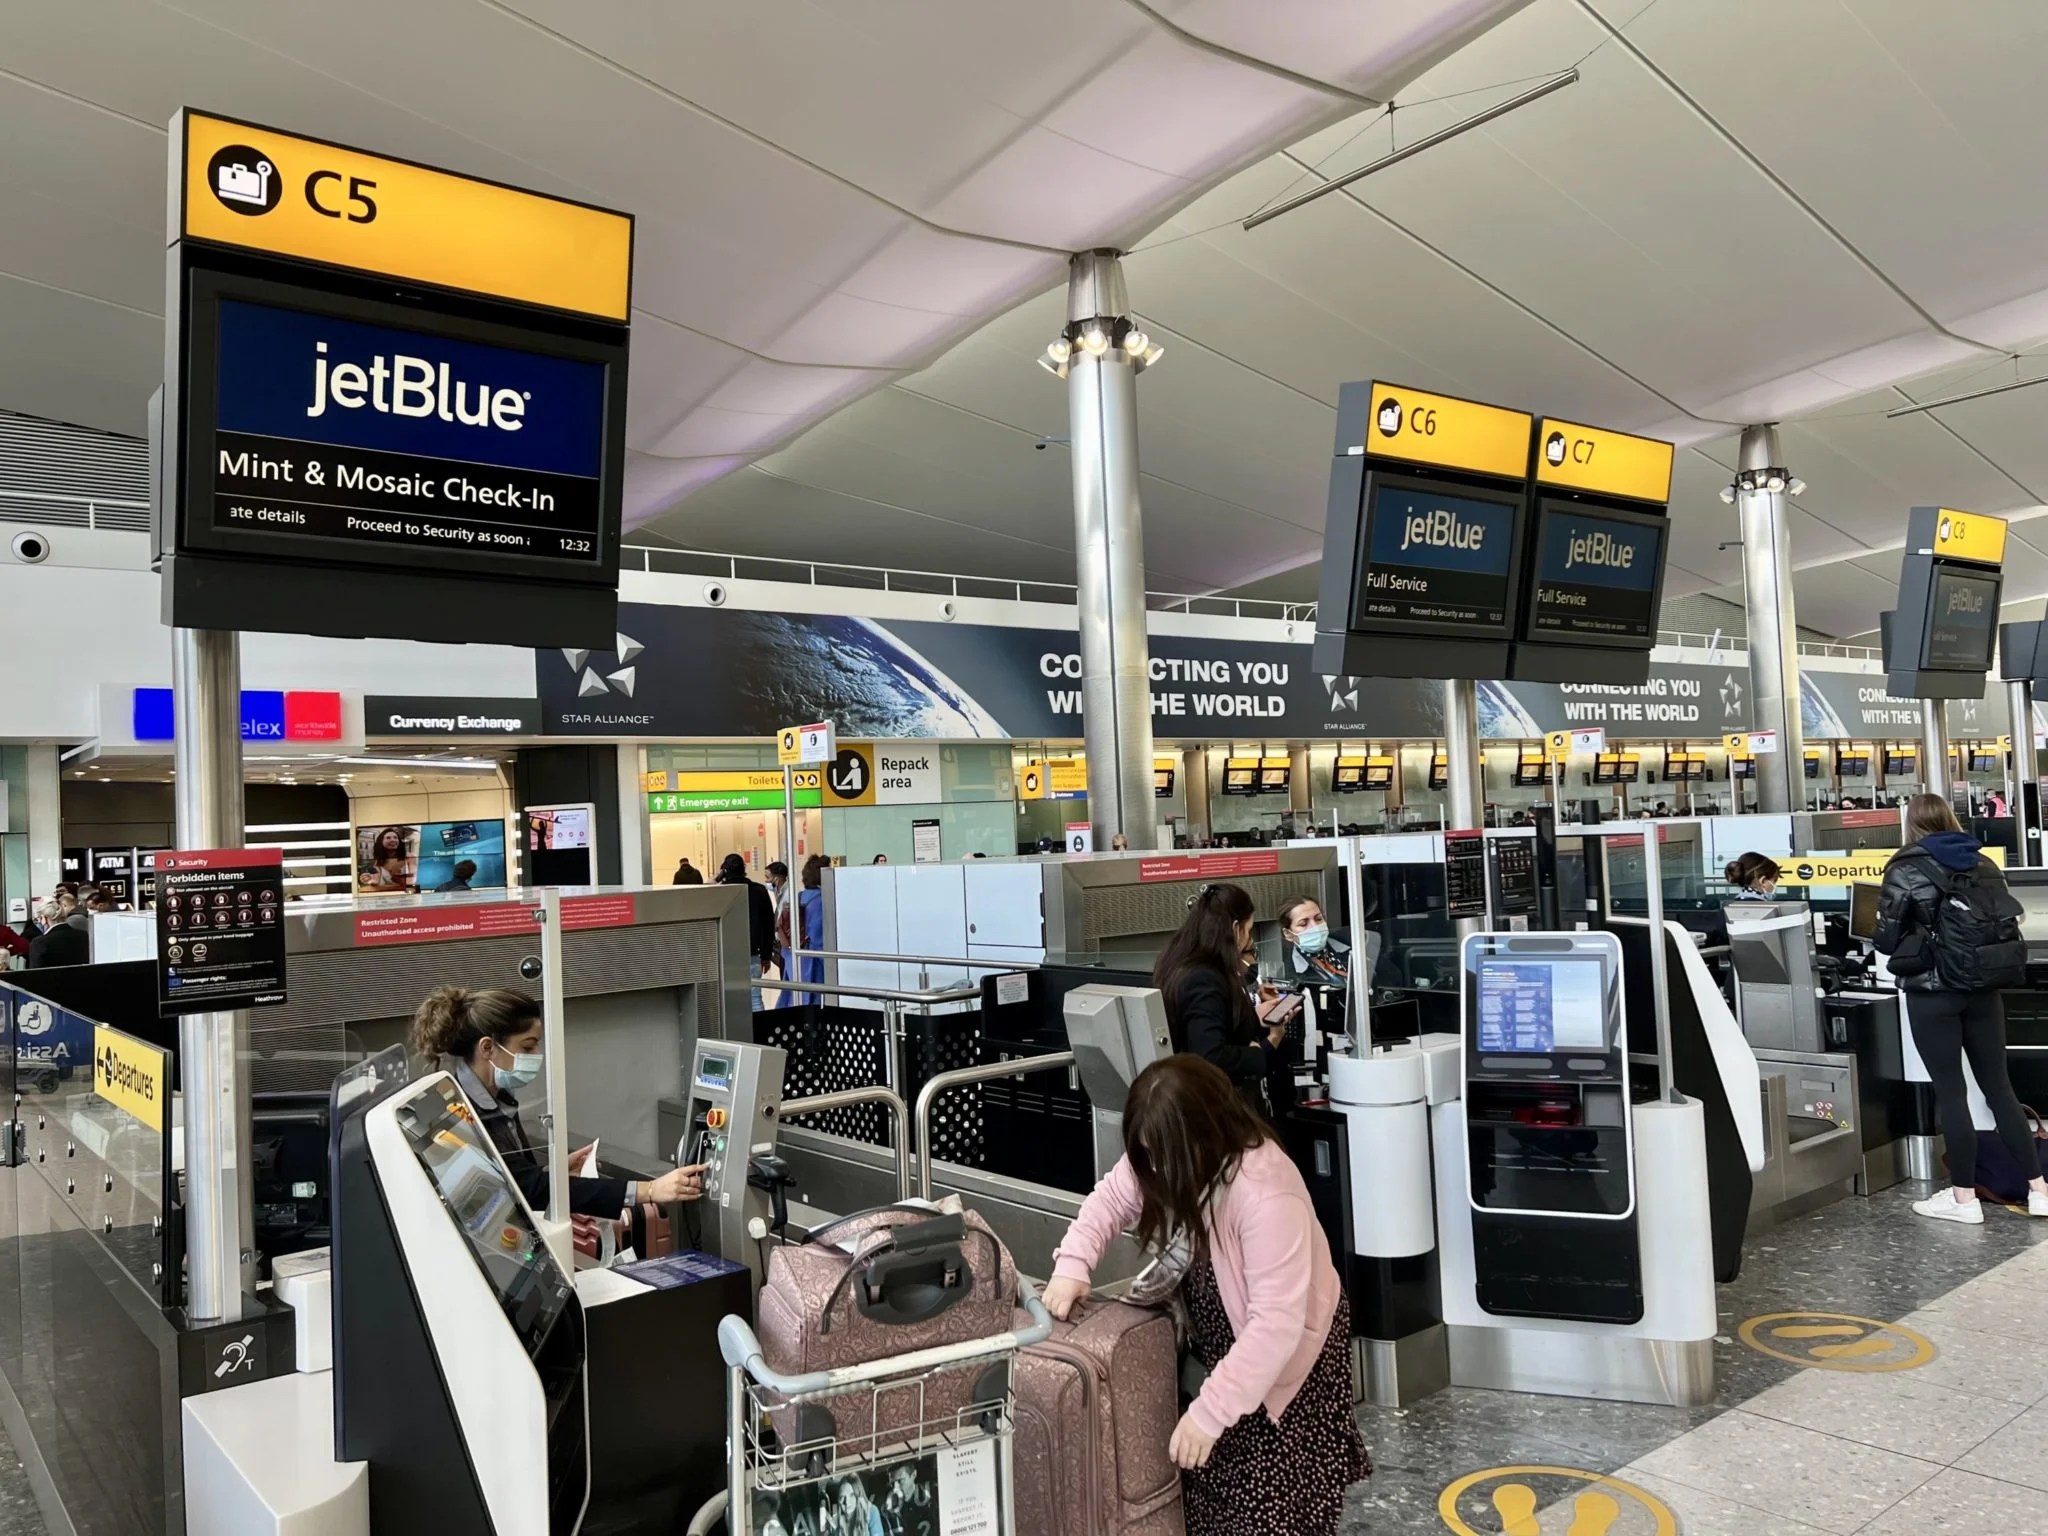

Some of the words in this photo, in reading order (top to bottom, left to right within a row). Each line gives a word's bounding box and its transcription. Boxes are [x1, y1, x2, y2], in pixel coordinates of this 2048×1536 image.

[304, 169, 378, 225] C5
[1410, 407, 1436, 436] C6
[1573, 439, 1595, 465] C7
[218, 449, 294, 483] Mint
[304, 461, 326, 486] &
[336, 464, 435, 498] Mosaic
[443, 477, 555, 512] Check-In
[257, 507, 306, 525] details
[347, 517, 402, 534] Proceed
[405, 523, 420, 536] to
[423, 524, 475, 544] Security
[477, 531, 491, 543] as
[493, 532, 524, 546] soon
[1954, 522, 1965, 539] C8
[560, 538, 590, 552] 12:32
[1566, 529, 1634, 569] jetBlue
[1367, 573, 1387, 590] Full
[1390, 574, 1428, 592] Service
[1537, 588, 1554, 603] Full
[1556, 591, 1587, 606] Service
[1410, 607, 1430, 616] Proceed
[1438, 609, 1457, 619] Security
[1236, 662, 1289, 686] YOU
[1669, 679, 1700, 697] YOU
[1150, 693, 1186, 716] HE
[1191, 695, 1286, 717] WORLD
[1564, 702, 1607, 720] WITH
[1610, 703, 1642, 721] THE
[1645, 704, 1699, 722] WORLD
[390, 714, 455, 731] Currency
[457, 715, 522, 732] Exchange
[562, 714, 591, 723] STAR
[1862, 710, 1889, 724] WITH
[1890, 710, 1912, 724] THE
[881, 757, 929, 773] Repack
[748, 776, 779, 786] Toilets
[882, 776, 912, 789] area
[680, 797, 730, 809] Emergency
[732, 797, 749, 806] exit
[99, 857, 125, 869] ATM
[178, 859, 208, 867] Security
[166, 873, 216, 883] Forbidden
[218, 872, 245, 880] items
[1817, 865, 1884, 880] Departu
[361, 917, 398, 927] Restricted
[399, 916, 417, 925] Zone
[361, 927, 411, 938] Unauthorised
[413, 926, 436, 935] access
[437, 923, 473, 933] prohibited
[255, 995, 284, 1003] Heathrow
[113, 1051, 153, 1101] Departures
[953, 1449, 978, 1459] SLAVERY
